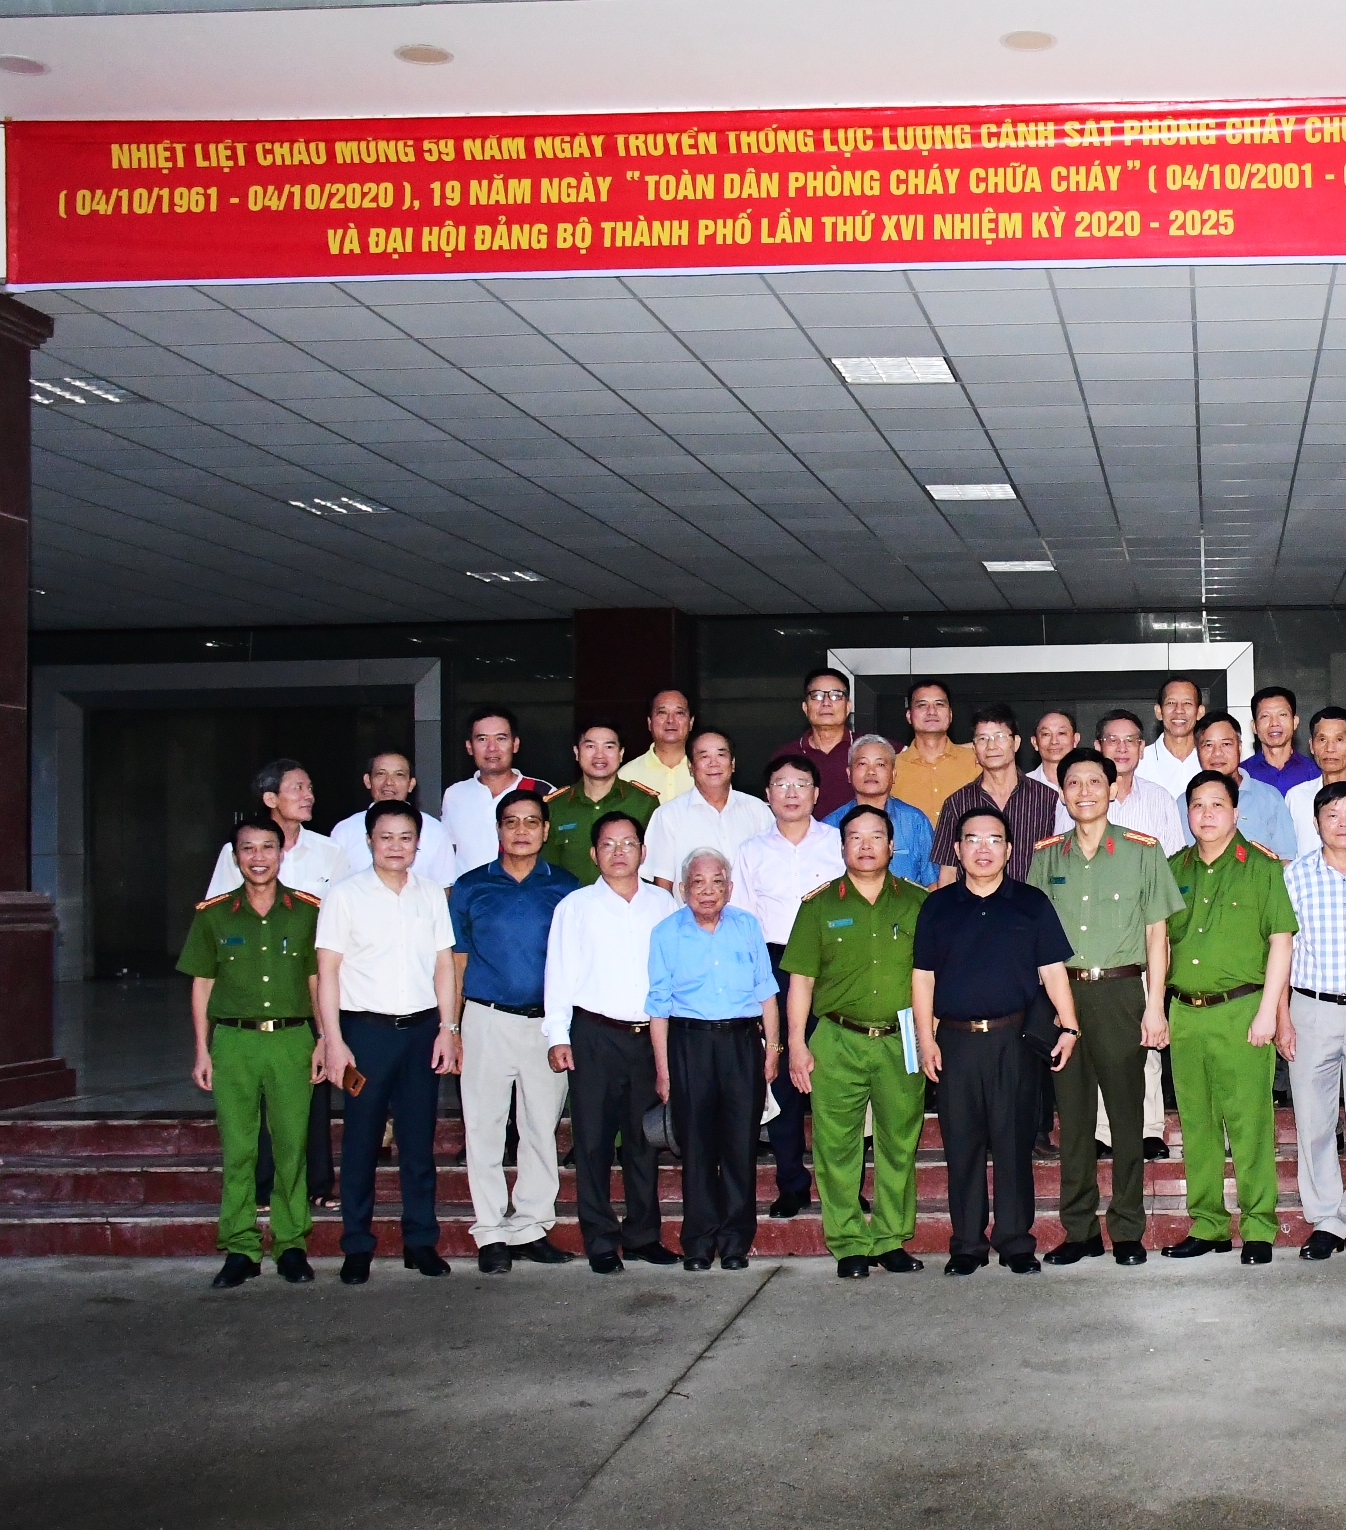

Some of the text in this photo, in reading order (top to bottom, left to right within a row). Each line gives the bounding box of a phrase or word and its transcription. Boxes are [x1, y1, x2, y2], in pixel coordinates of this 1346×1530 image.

[112, 140, 186, 173] NHIỆT
[194, 139, 247, 172] LIỆT
[255, 137, 327, 166] CHÀO
[423, 138, 455, 162] 59
[464, 134, 527, 161] NĂM
[533, 132, 605, 159] NGÀY
[614, 126, 718, 157] TRUYỀN
[726, 124, 815, 153] THỐNG
[822, 127, 874, 157] LỰC
[882, 124, 973, 155] LƯỢNG
[980, 118, 1056, 149] CẢNH
[1063, 118, 1116, 148] SÁT
[1123, 115, 1217, 147] PHÒNG
[1225, 113, 1297, 145] CHÁY
[76, 187, 218, 215] 04/10/1961
[248, 183, 394, 211] 04/10/2020
[430, 181, 461, 207] 19
[470, 174, 532, 206] NĂM
[541, 172, 613, 203] NGÀY
[724, 168, 780, 199] DÂN
[789, 165, 881, 197] PHÒNG
[890, 164, 961, 195] CHÁY
[970, 162, 1043, 193] CHỮA
[1166, 163, 1313, 190] 04/10/2001
[327, 223, 361, 254] VÀ
[368, 228, 414, 258] ĐẠI
[421, 220, 466, 257] HỘI
[473, 215, 548, 251] ĐẢNG
[557, 217, 593, 254] BỘ
[601, 216, 689, 248] THÀNH
[698, 209, 752, 245] PHỐ
[761, 208, 813, 243] LẦN
[821, 210, 876, 242] THỨ
[881, 214, 924, 241] XVI
[933, 207, 1022, 246] NHIỆM
[1031, 206, 1067, 238] KỲ
[1074, 211, 1141, 238] 2020
[1168, 209, 1235, 236] 2025
